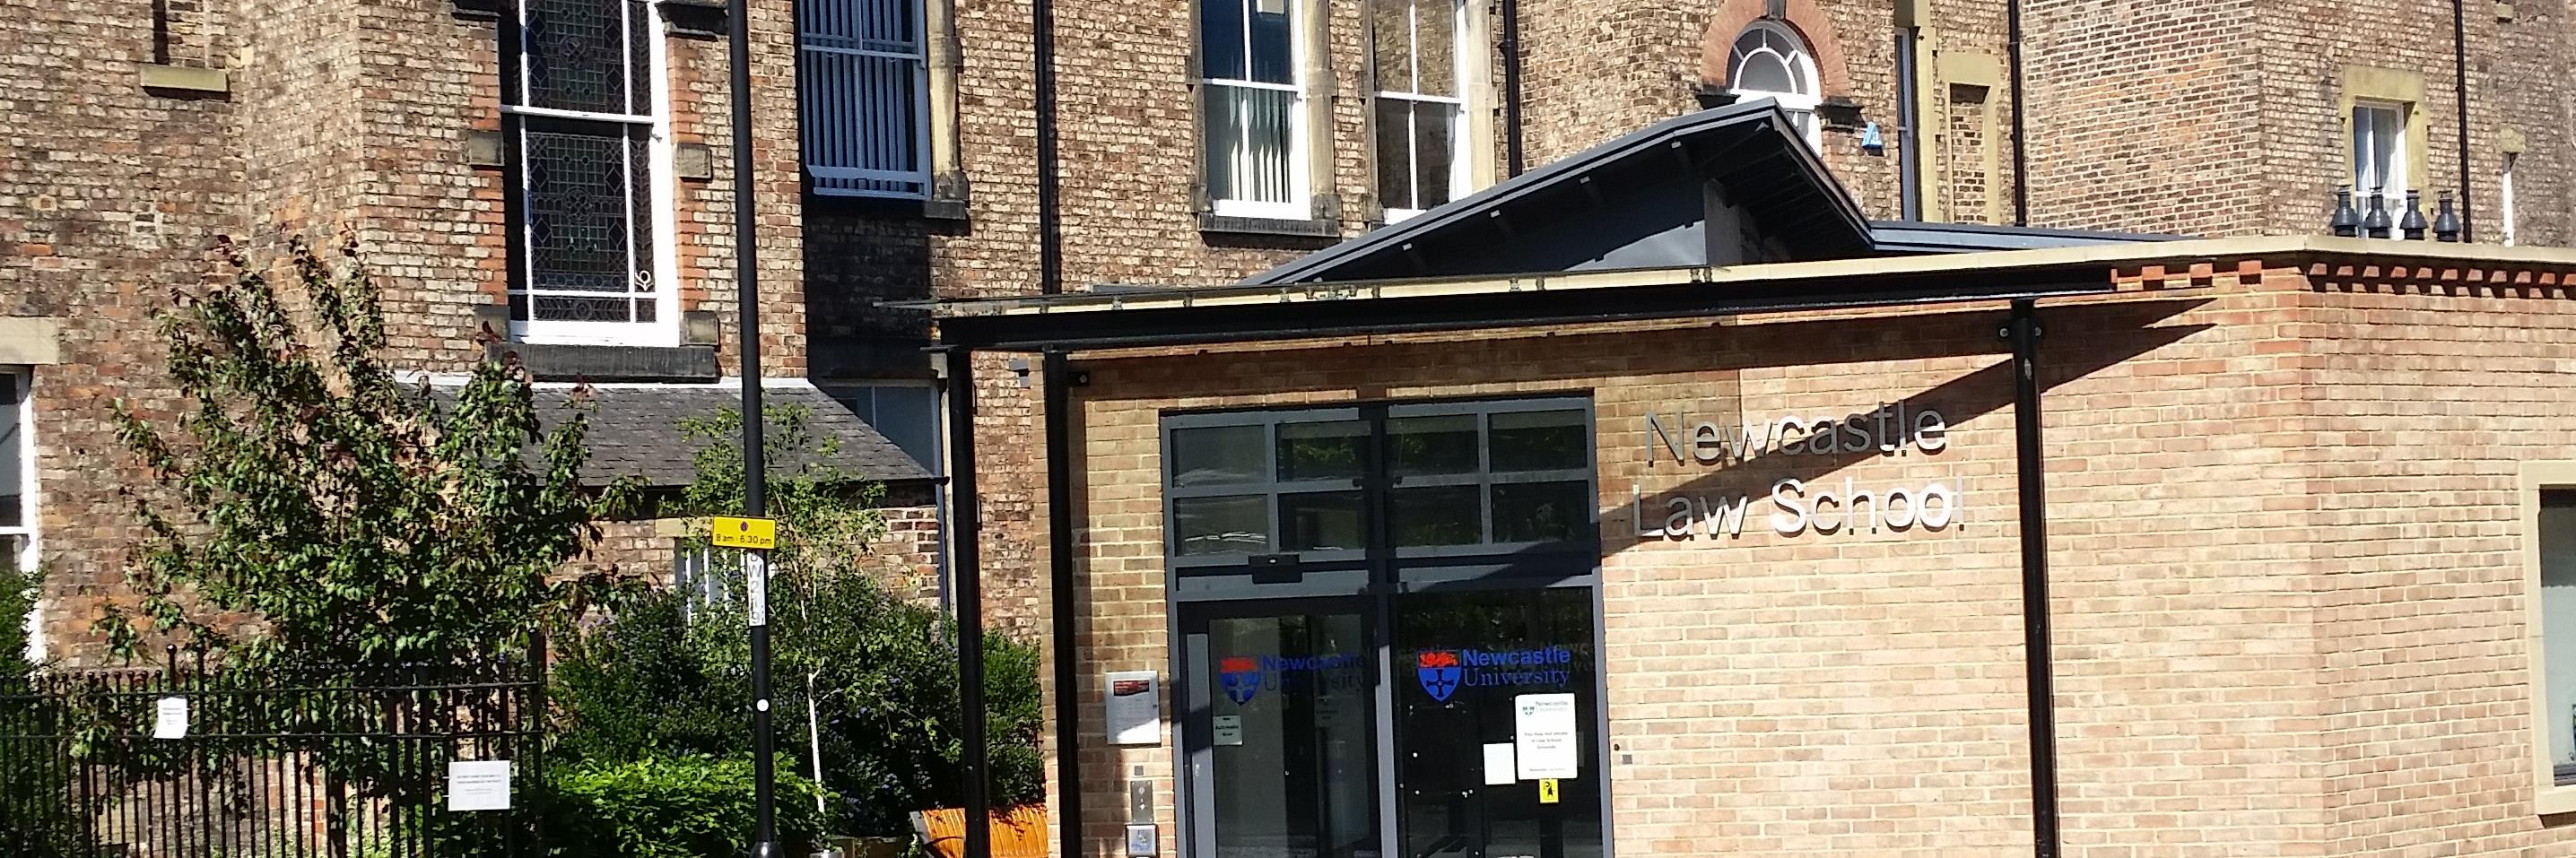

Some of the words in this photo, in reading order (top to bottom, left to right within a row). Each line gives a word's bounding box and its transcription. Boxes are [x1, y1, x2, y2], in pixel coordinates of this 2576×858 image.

[1645, 399, 1946, 465] Newcastle
[1632, 483, 1748, 540] Law
[1771, 476, 1965, 538] School
[1462, 647, 1571, 668] Newcastle
[1464, 667, 1571, 688] University
